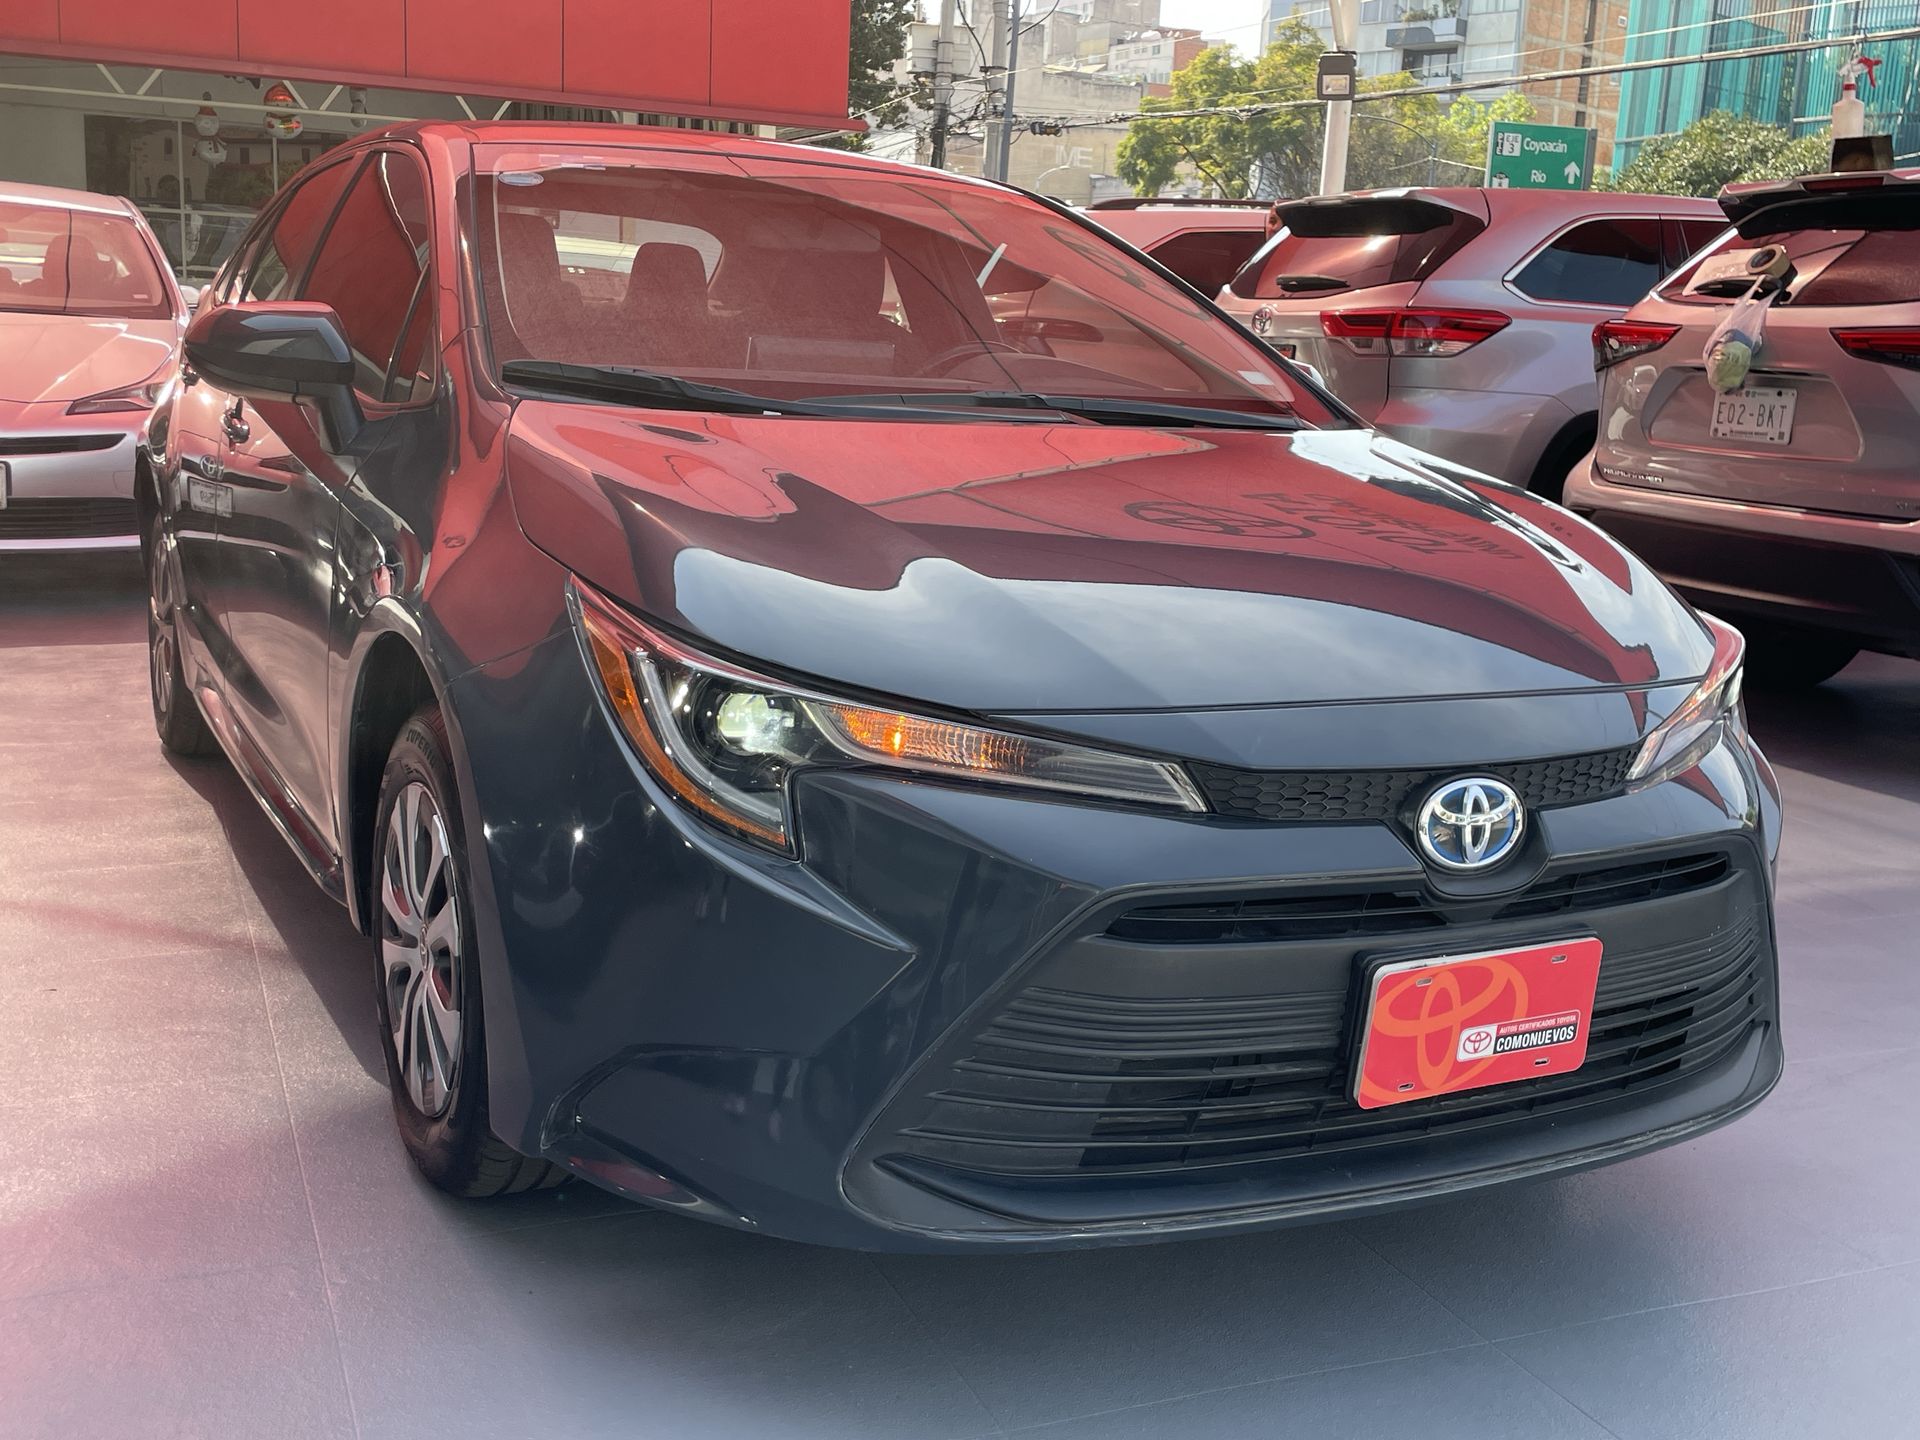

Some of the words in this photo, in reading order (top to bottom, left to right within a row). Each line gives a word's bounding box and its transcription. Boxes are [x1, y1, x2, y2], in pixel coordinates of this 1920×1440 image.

[1506, 135, 1520, 143] EJE
[1508, 143, 1515, 153] 3
[1523, 138, 1567, 155] Coyoacán
[1716, 401, 1787, 429] E02-BKT
[1499, 1025, 1517, 1034] AUTOS
[1518, 1018, 1556, 1031] CERTIFICADOS
[1557, 1015, 1576, 1025] TOYOTA
[1496, 1025, 1575, 1052] COMONUEVOS
